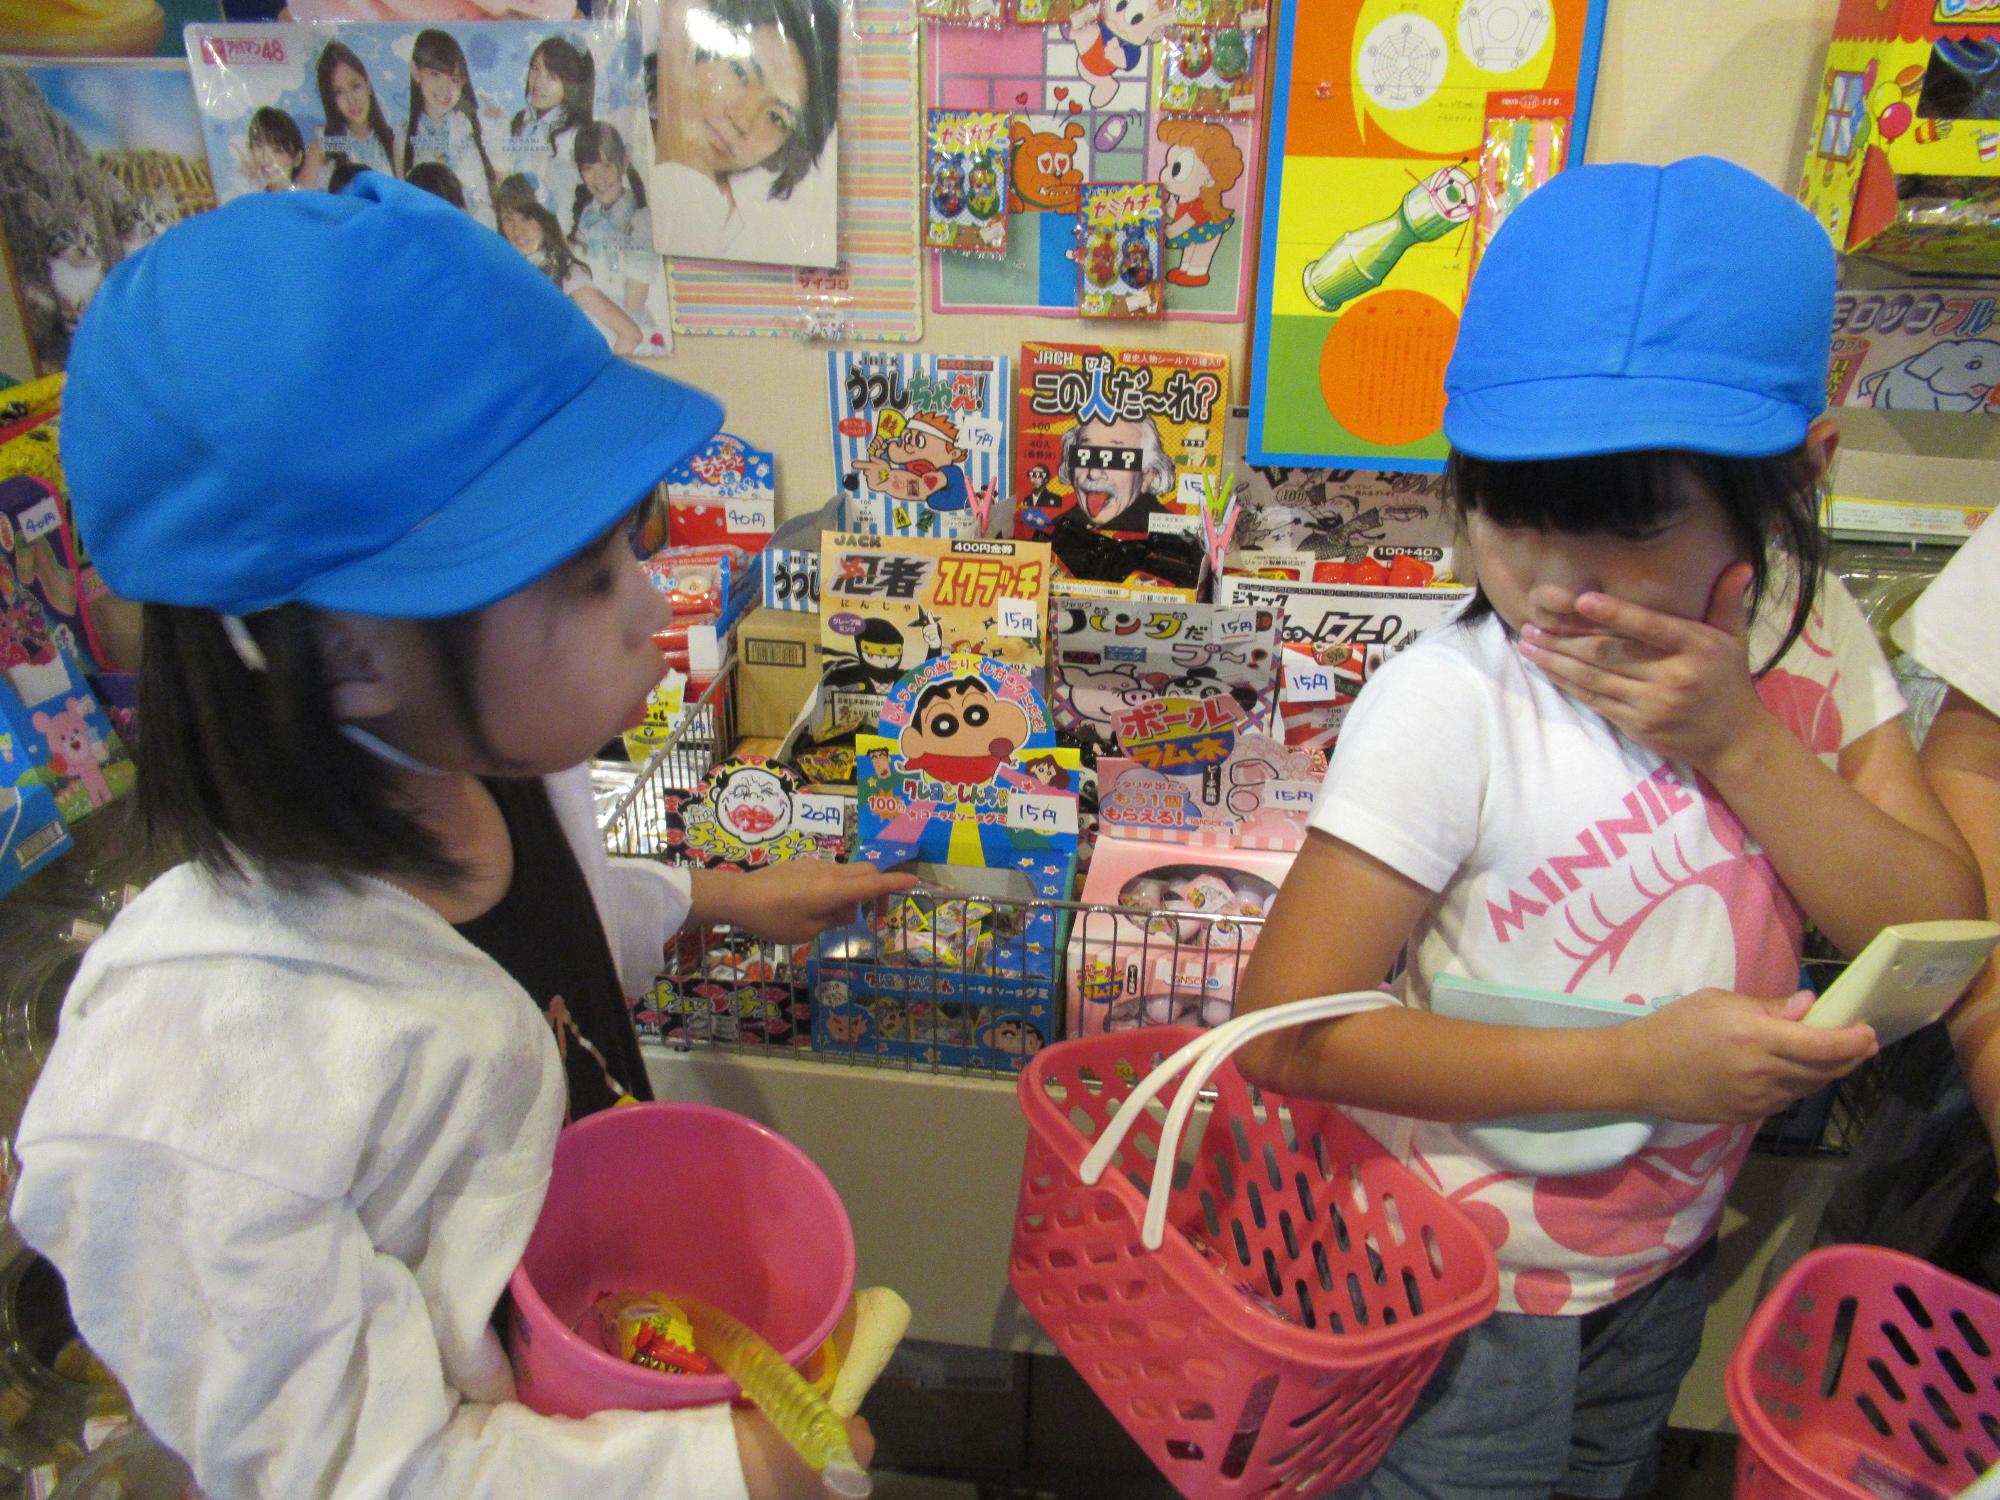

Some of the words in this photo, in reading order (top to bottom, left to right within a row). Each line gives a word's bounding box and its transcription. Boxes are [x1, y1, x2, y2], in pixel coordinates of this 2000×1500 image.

[968, 428, 994, 447] 15円
[834, 534, 882, 548] JACK
[831, 554, 934, 598] 忍者
[934, 557, 1042, 608] スクラッチ
[1004, 611, 1033, 632] 15円
[1220, 620, 1254, 634] 15円
[1292, 672, 1329, 691] 15円
[1119, 695, 1236, 740] ボール
[1131, 736, 1229, 770] ラムネ
[1275, 789, 1313, 802] 15円
[800, 802, 841, 825] 20円
[1018, 804, 1058, 825] 15円
[1103, 807, 1184, 826] もらえる!
[672, 852, 706, 869] Jack
[1486, 760, 1694, 943] MINNIE
